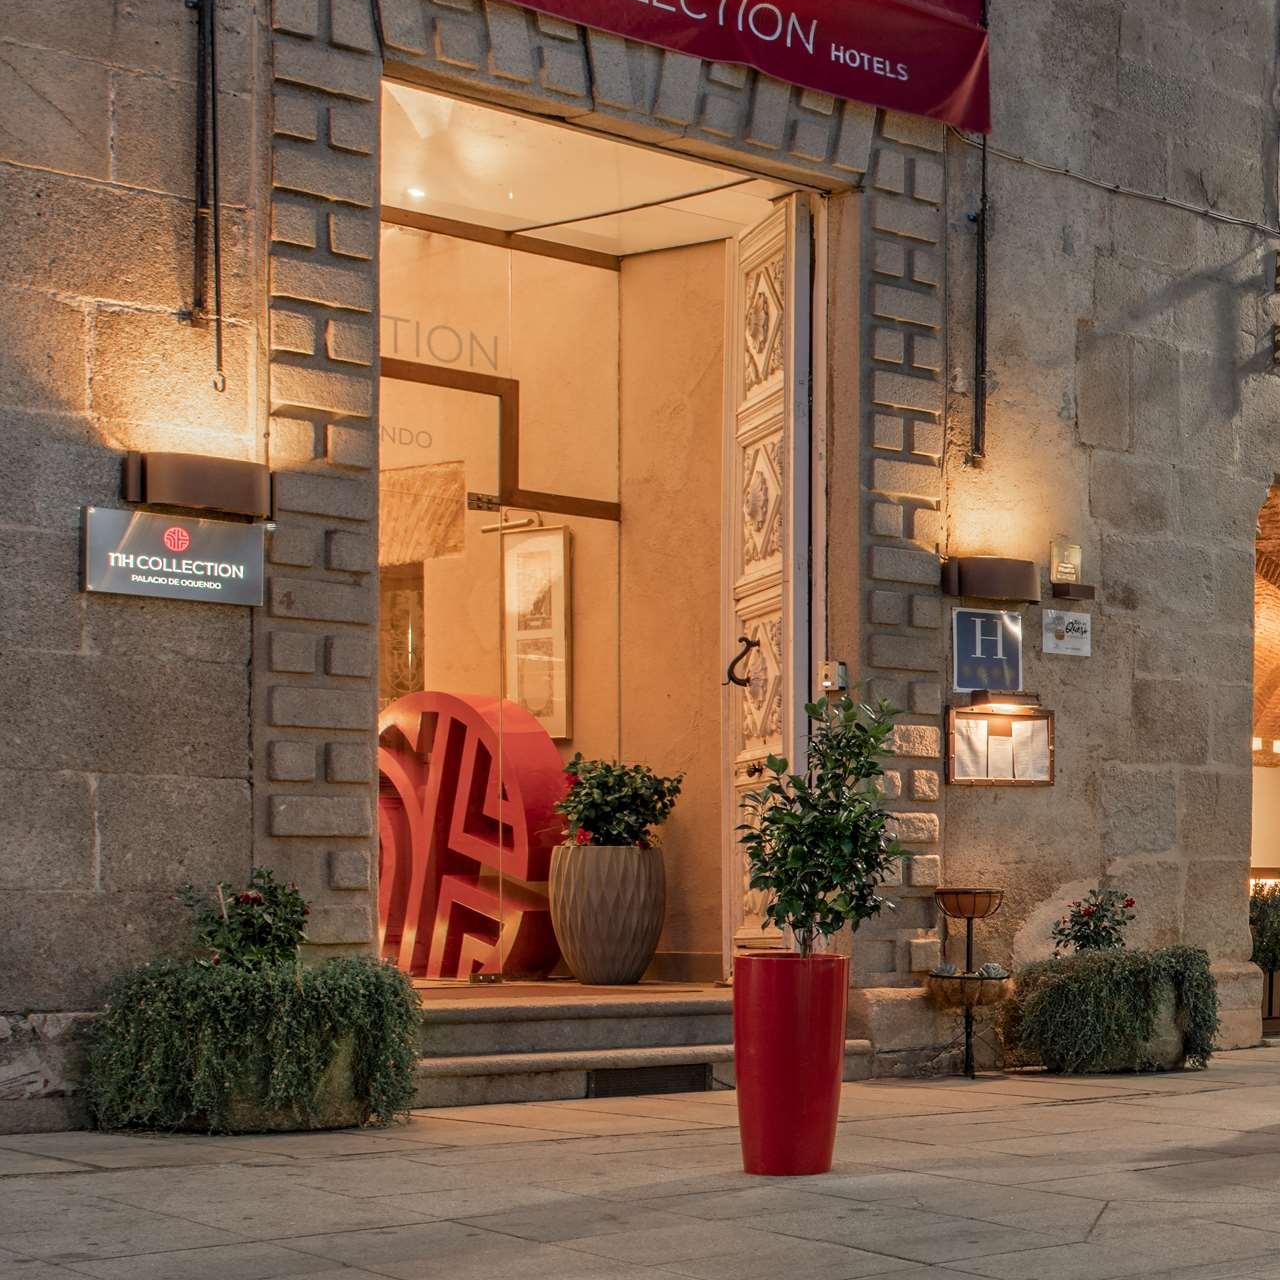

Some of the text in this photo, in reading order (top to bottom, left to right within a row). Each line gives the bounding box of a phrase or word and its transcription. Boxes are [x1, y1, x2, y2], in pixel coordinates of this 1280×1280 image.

[830, 43, 909, 82] HOTELS
[131, 574, 222, 590] PALACIO DE OQUENDO
[136, 554, 244, 579] COLLECTION
[971, 617, 1007, 659] H
